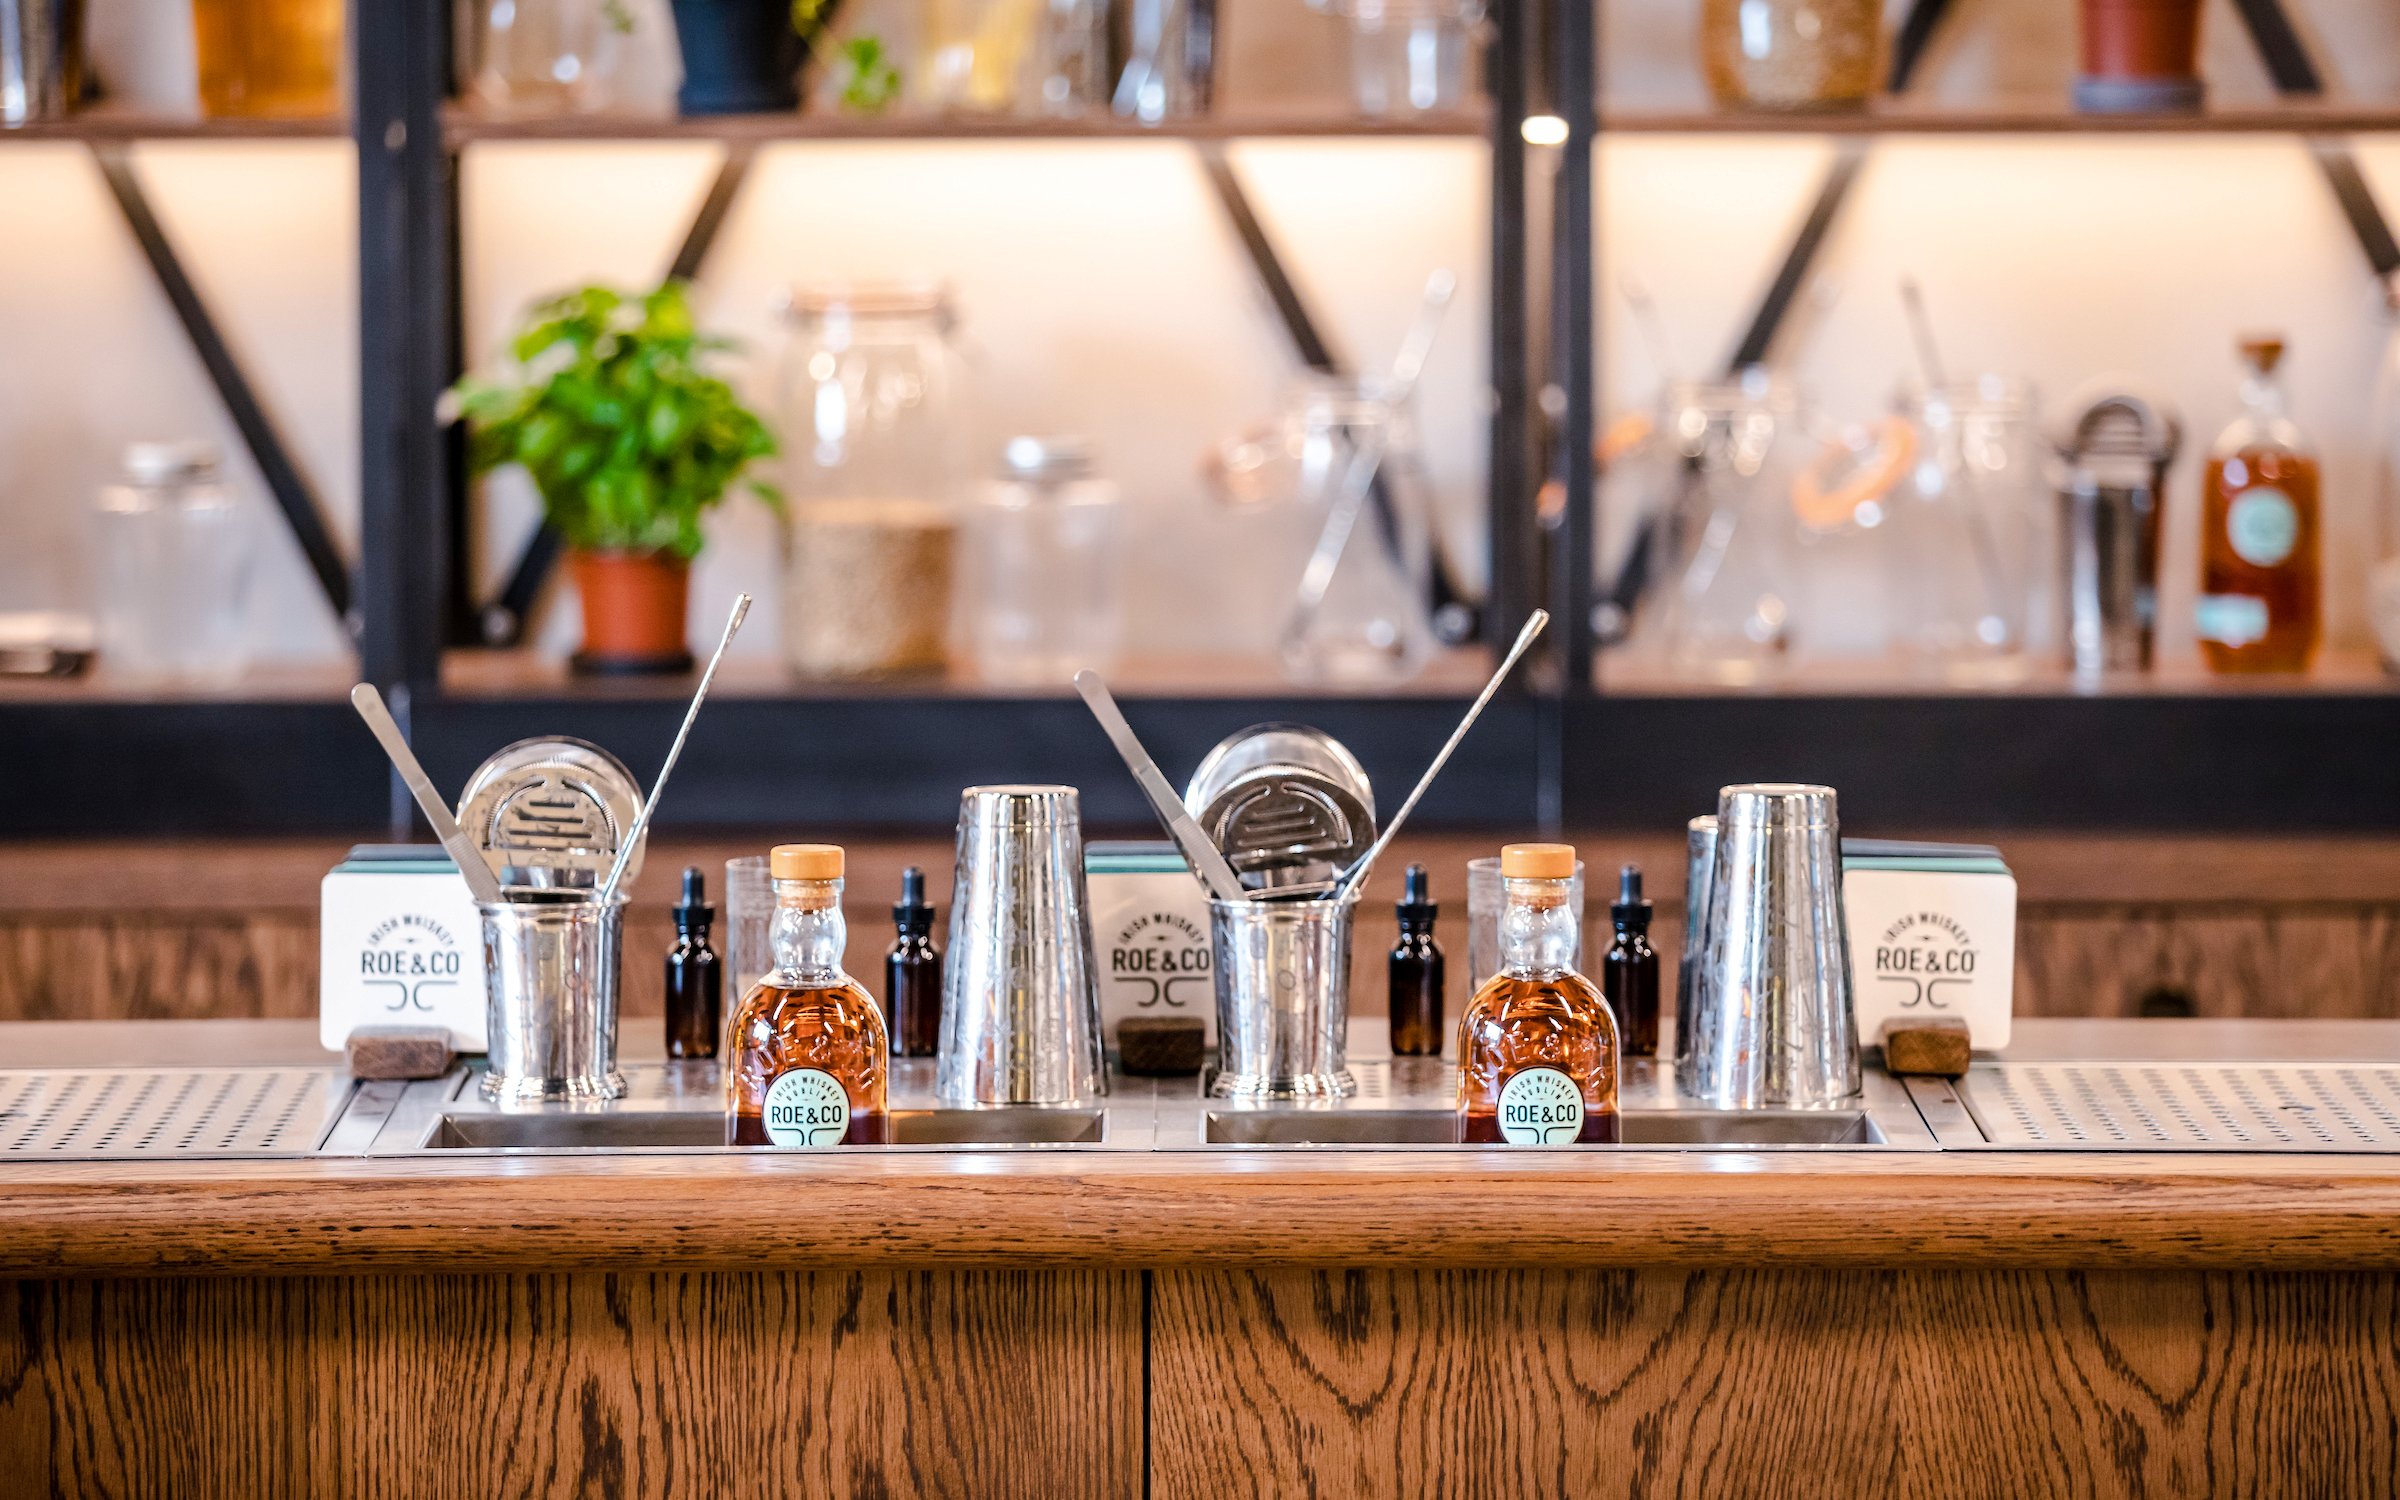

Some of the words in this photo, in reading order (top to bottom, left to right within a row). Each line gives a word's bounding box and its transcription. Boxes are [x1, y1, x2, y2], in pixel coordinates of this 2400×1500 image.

[368, 917, 398, 946] IRISH
[402, 914, 454, 946] WHISKEY
[1882, 913, 1914, 944] IRISH
[1919, 912, 1970, 946] WHISKEY
[362, 950, 459, 975] ROE&CO
[1113, 948, 1209, 972] ROE&CO
[1876, 947, 1974, 973] ROE&CO
[774, 1078, 796, 1101] IRISH
[802, 1076, 840, 1101] WHISKEY
[786, 1087, 826, 1101] DUBLIN
[1508, 1077, 1531, 1100] IRISH
[1537, 1075, 1574, 1100] WHISKEY
[1521, 1086, 1561, 1101] DUBLIN
[772, 1105, 842, 1124] ROE&CO
[1506, 1104, 1576, 1123] ROE&CO
